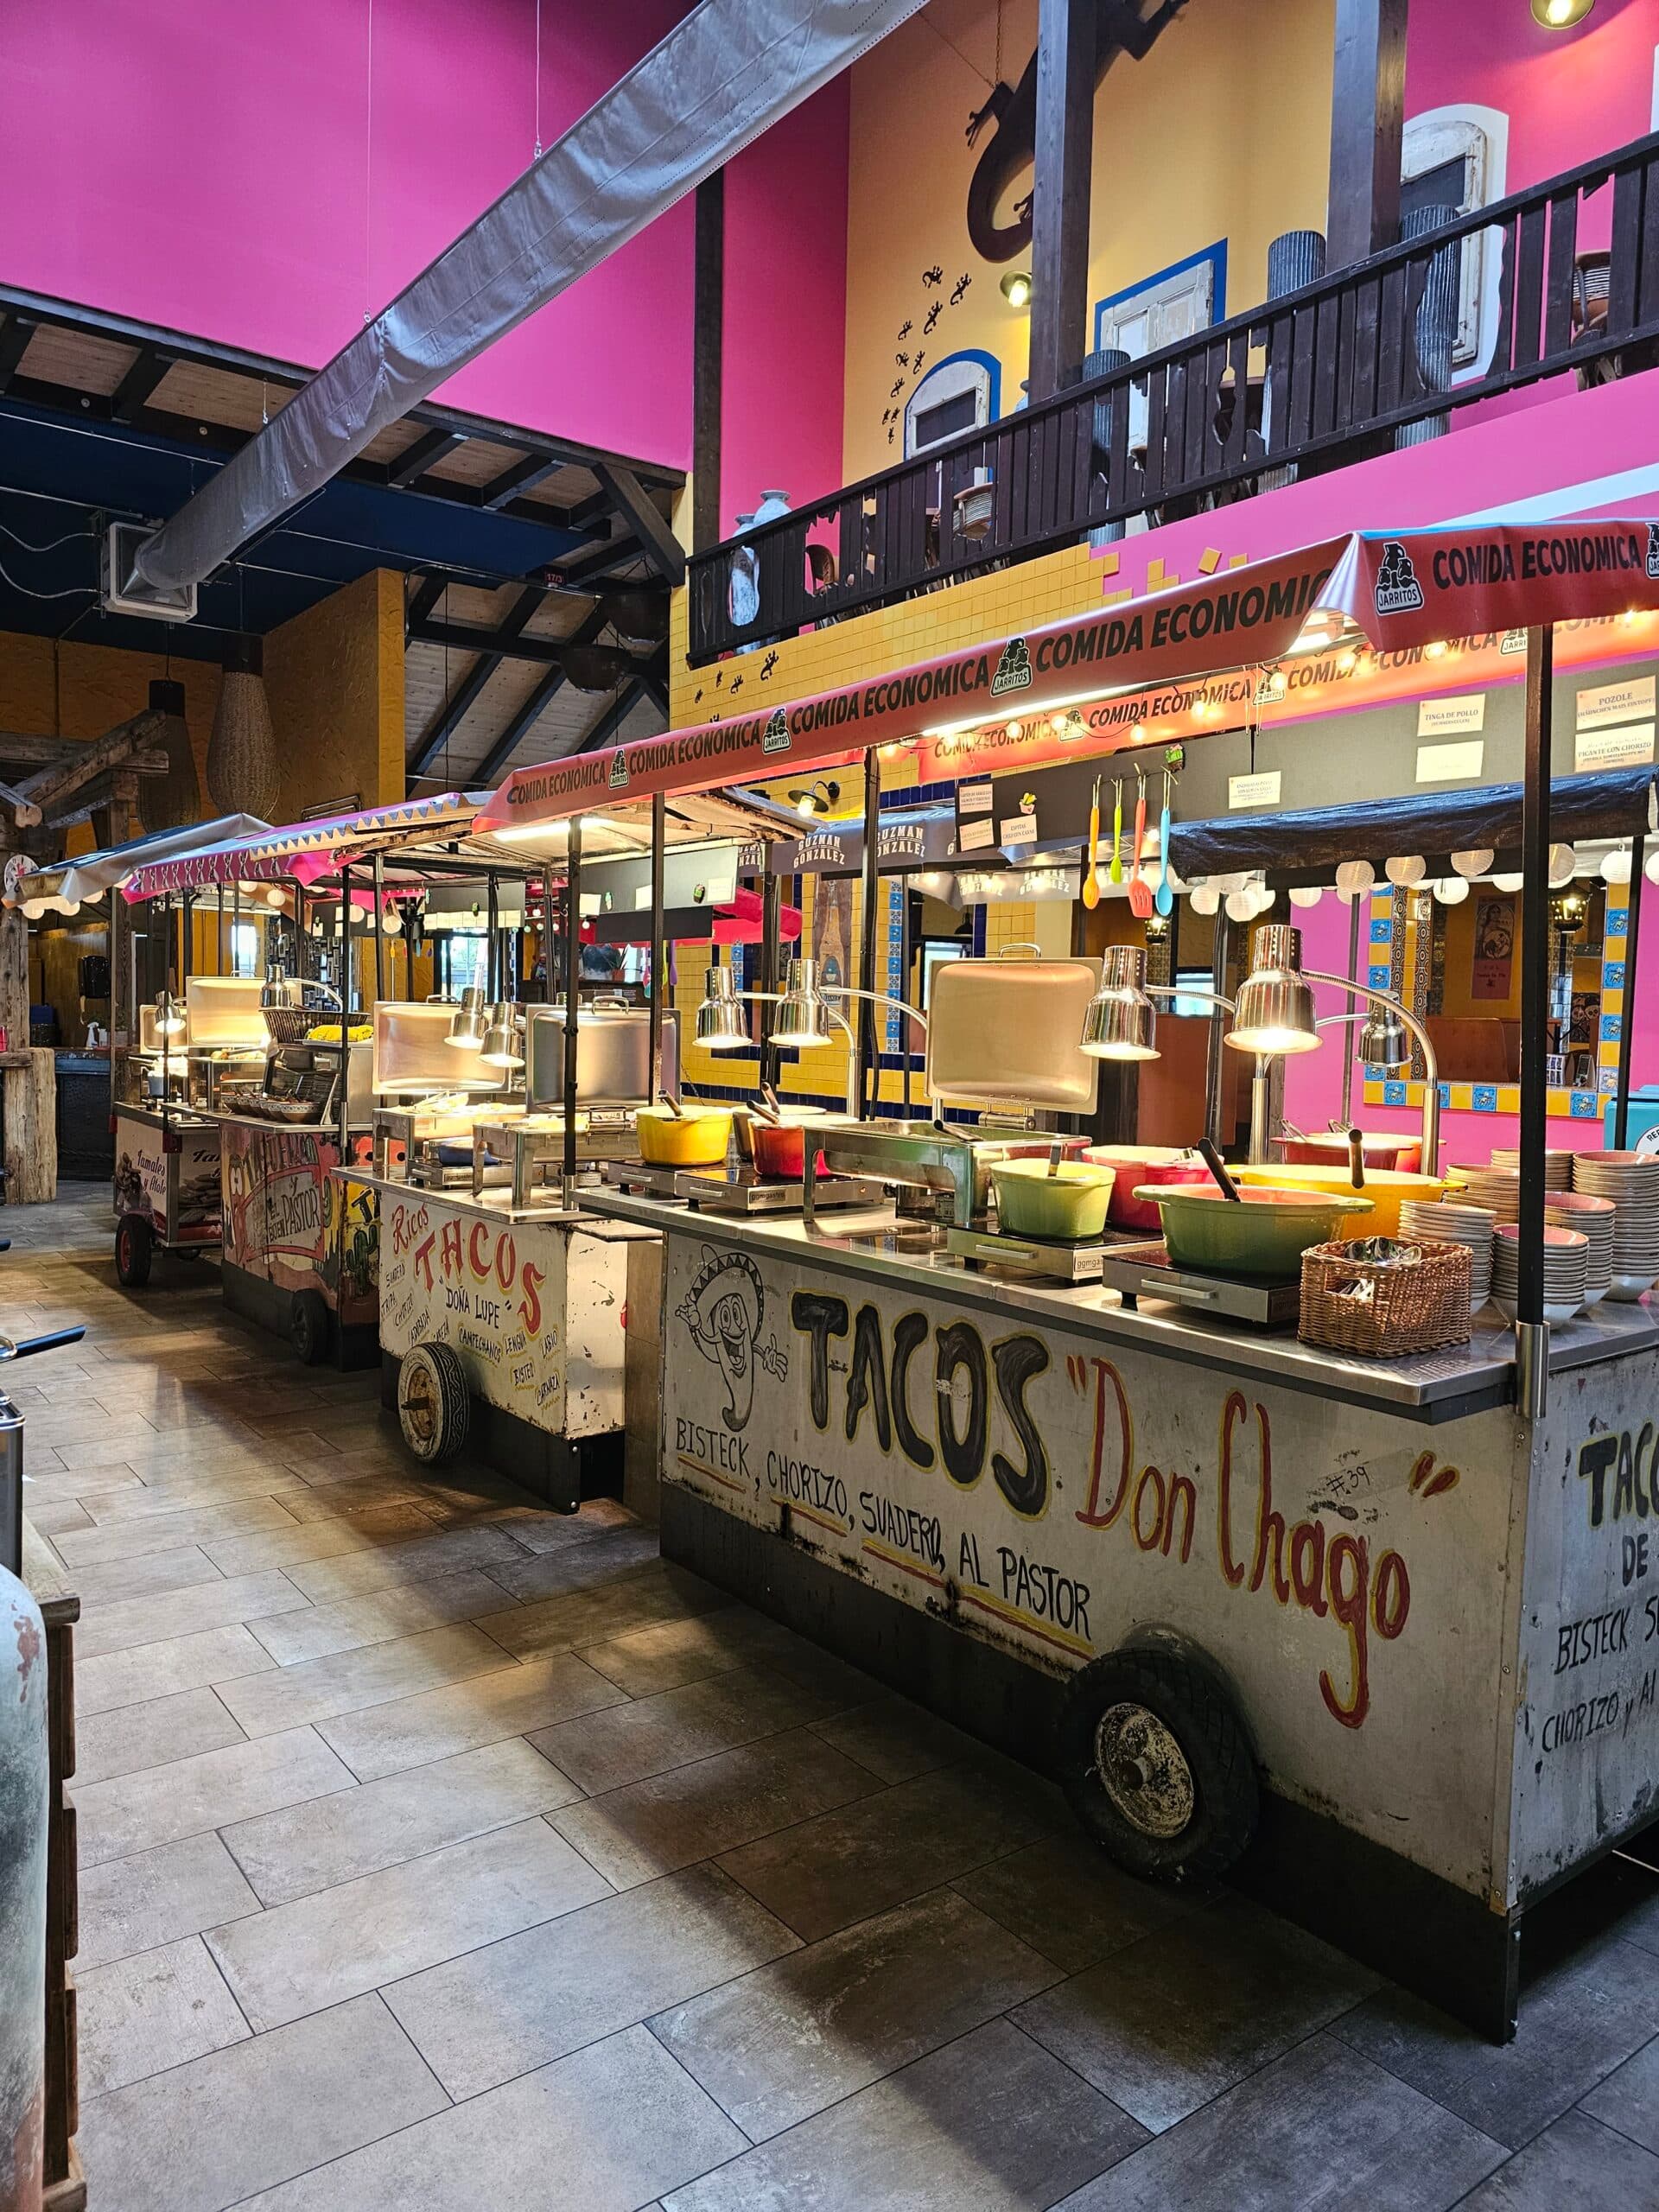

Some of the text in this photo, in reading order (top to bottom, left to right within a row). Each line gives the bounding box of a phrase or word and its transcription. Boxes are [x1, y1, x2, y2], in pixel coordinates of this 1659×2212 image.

[1433, 534, 1642, 590] COMIDA ECONOMICA
[1378, 588, 1418, 607] JARRITOS
[1037, 569, 1333, 672] COMIDA ECONOMIC
[791, 655, 989, 734] COMIDA ECONOMICA
[995, 674, 1028, 690] JARRITOS
[1090, 679, 1251, 728] COMIDA ECONOMICA
[1456, 709, 1478, 717] POLLO
[1599, 692, 1633, 705] POZOLE
[629, 719, 761, 776] COMIDA ECONOMICA
[764, 734, 789, 749] JARRITOS
[1607, 745, 1621, 753] CON
[1622, 741, 1652, 751] CHORIZO
[507, 760, 605, 804] COMIDA ECONOMICA
[609, 773, 627, 786] JARRITOS
[798, 835, 841, 851] GUZMAN
[877, 825, 924, 842] UZMAN
[877, 840, 925, 858] ONZALEZ
[793, 849, 845, 868] GONZALEZ
[137, 1149, 166, 1177] Tamales
[143, 1173, 167, 1196] y Atole
[282, 1187, 321, 1236] PASTOR
[392, 1202, 429, 1255] Ricos
[415, 1218, 546, 1335] TACOS
[1077, 1258, 1103, 1269] ggmga
[458, 1328, 501, 1363] CAMPECHANOS
[504, 1331, 526, 1353] LENGUA
[541, 1330, 558, 1358] LABIO
[537, 1373, 560, 1407] CARNAZA
[791, 1291, 1049, 1516] TACOS
[766, 1451, 855, 1531] CHORIZO,
[959, 1532, 989, 1588] AL
[996, 1546, 1092, 1641] PASTOR
[1622, 1533, 1649, 1587] DE
[1554, 1605, 1631, 1675] BISTECK
[1541, 1691, 1618, 1753] CHORIZO
